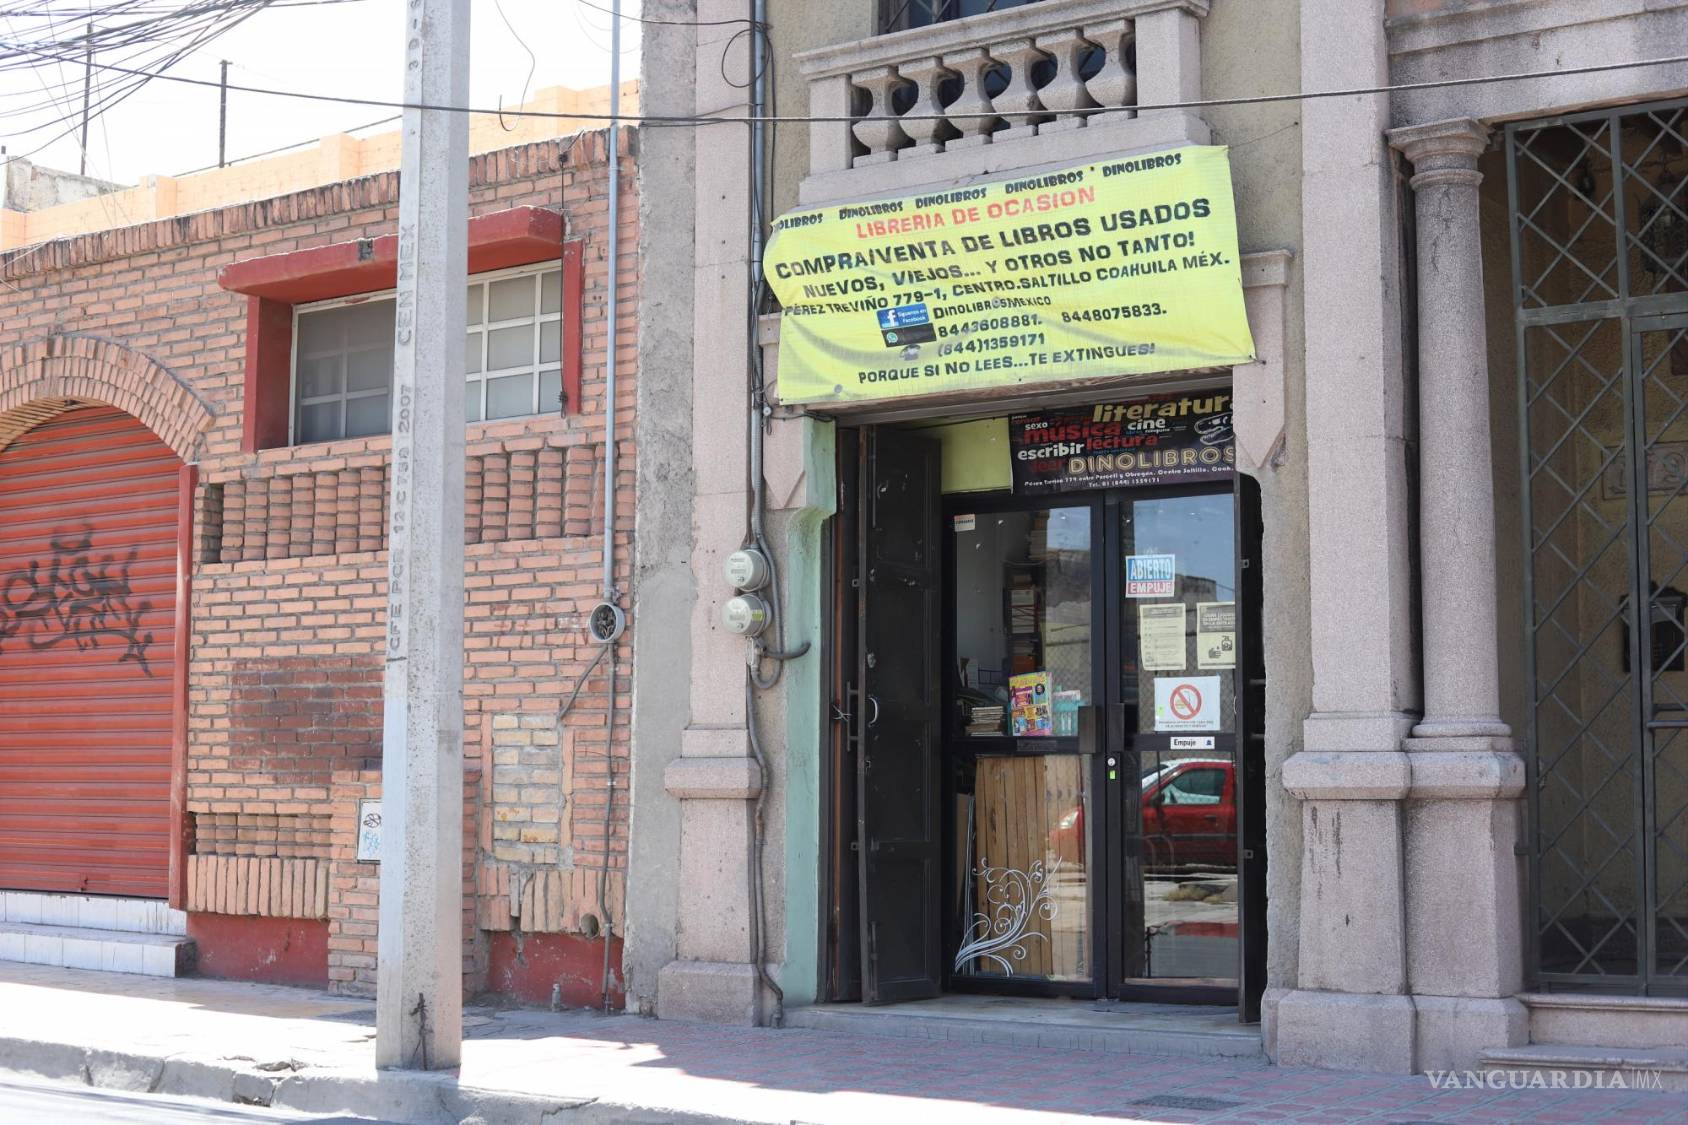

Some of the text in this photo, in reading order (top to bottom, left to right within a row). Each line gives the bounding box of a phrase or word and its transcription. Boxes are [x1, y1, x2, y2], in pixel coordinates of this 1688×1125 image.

[839, 201, 903, 220] DINOLIBROS
[915, 187, 987, 209] DINOLIBROS
[1005, 171, 1083, 194] DINOLIBROS
[1102, 153, 1182, 177] DINOLIBROS
[856, 186, 1095, 239] LIBRERIA DE OCASION
[961, 234, 994, 252] DE
[999, 218, 1091, 247] LIBROS
[1100, 198, 1211, 232] USADOS
[803, 276, 885, 298] NUEVOS,
[985, 260, 997, 273] Y
[1005, 250, 1073, 271] OTROS
[1078, 244, 1111, 262] NO
[1117, 231, 1195, 257] TANTO!
[826, 295, 888, 313] TREVIÑO
[893, 287, 947, 305] 779-1,
[1096, 259, 1177, 282] COAHUILA
[1182, 251, 1230, 269] MÉX.
[858, 368, 919, 384] PORQUE
[924, 364, 940, 377] SI
[945, 361, 970, 375] NO
[1052, 343, 1156, 363] EXTINGUES!
[1092, 395, 1234, 423] literatur
[1025, 421, 1048, 431] sexo
[1017, 442, 1085, 460] escribir
[1086, 435, 1158, 451] lectura
[1068, 446, 1235, 475] DINOLIBROS
[1130, 558, 1171, 580] ABIERTO
[1130, 581, 1171, 593] EMPUJE
[389, 604, 402, 650] CFE
[1173, 738, 1196, 748] Empuje
